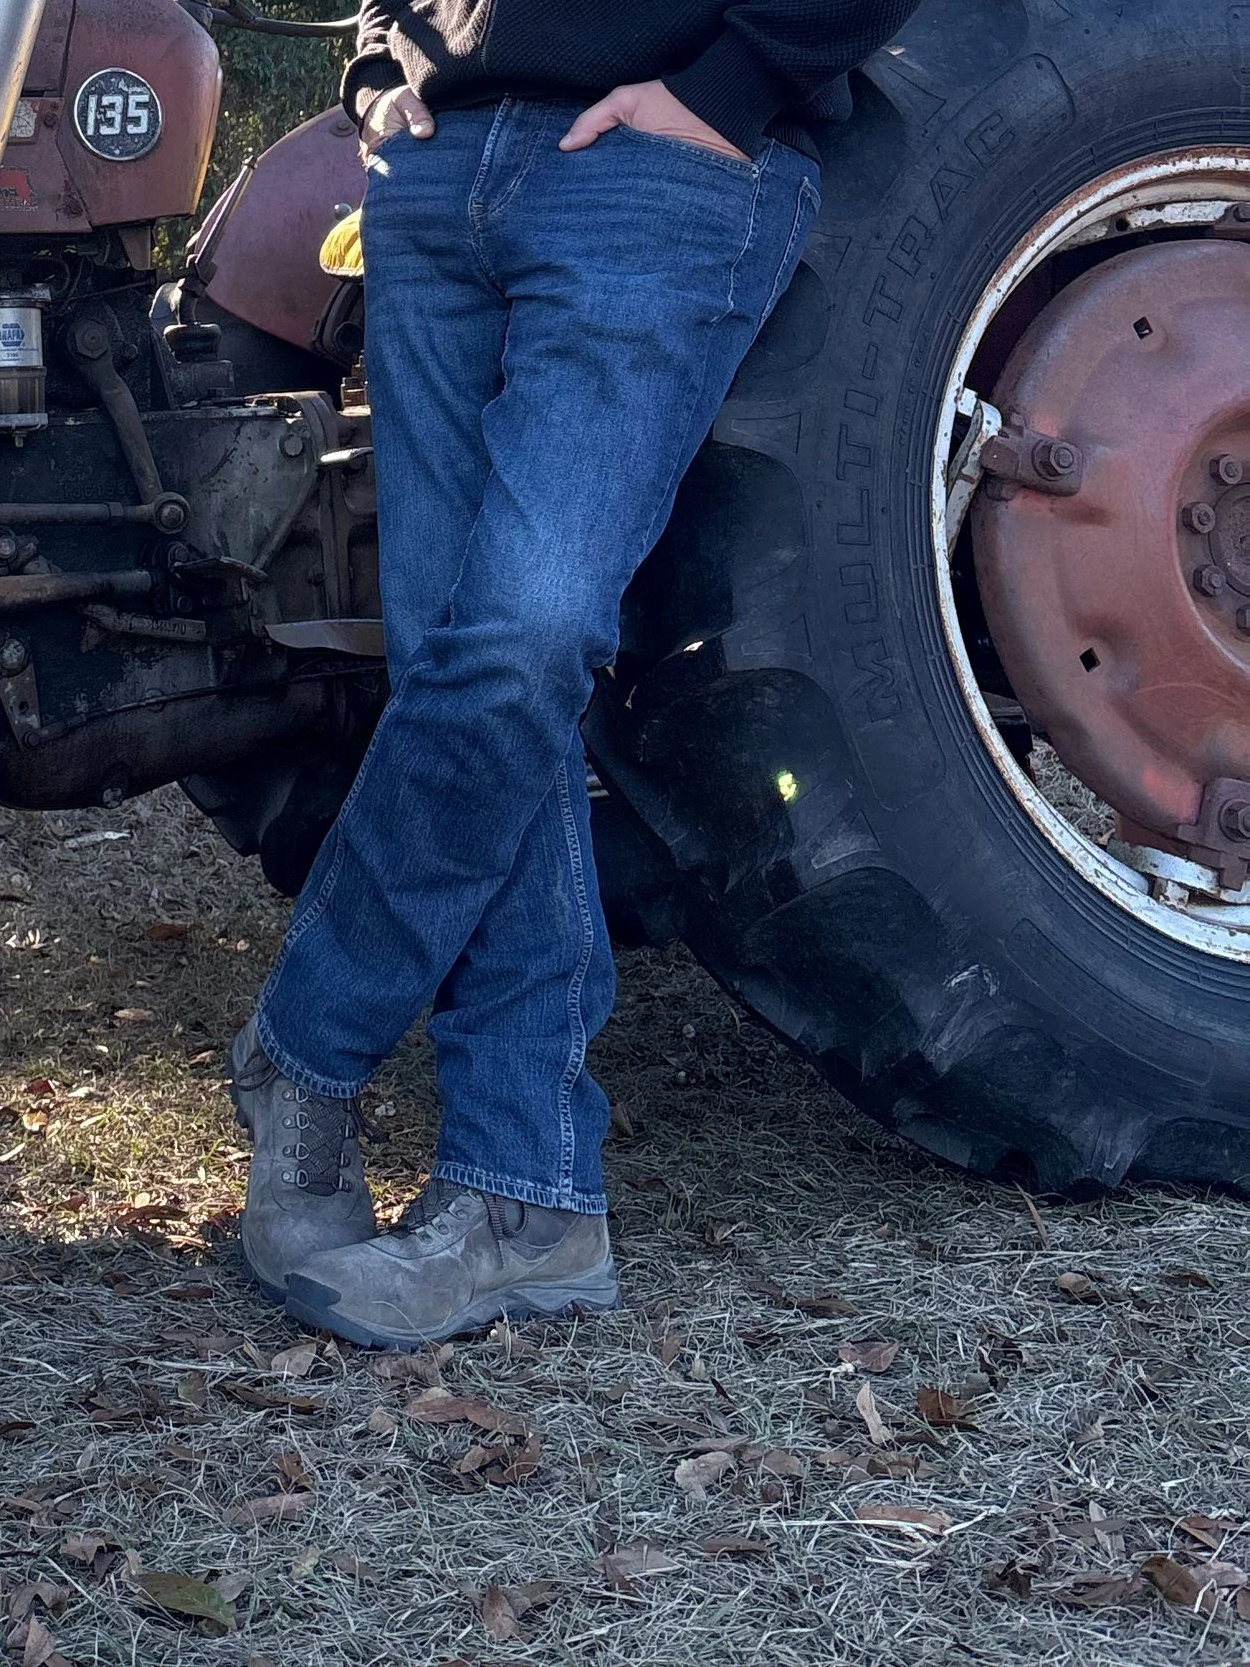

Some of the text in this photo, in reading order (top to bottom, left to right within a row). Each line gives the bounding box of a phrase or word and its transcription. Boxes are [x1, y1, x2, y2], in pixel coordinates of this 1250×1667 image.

[86, 93, 150, 136] 135
[2, 329, 22, 341] NAPA
[834, 110, 1017, 724] MULTI-TRAC
